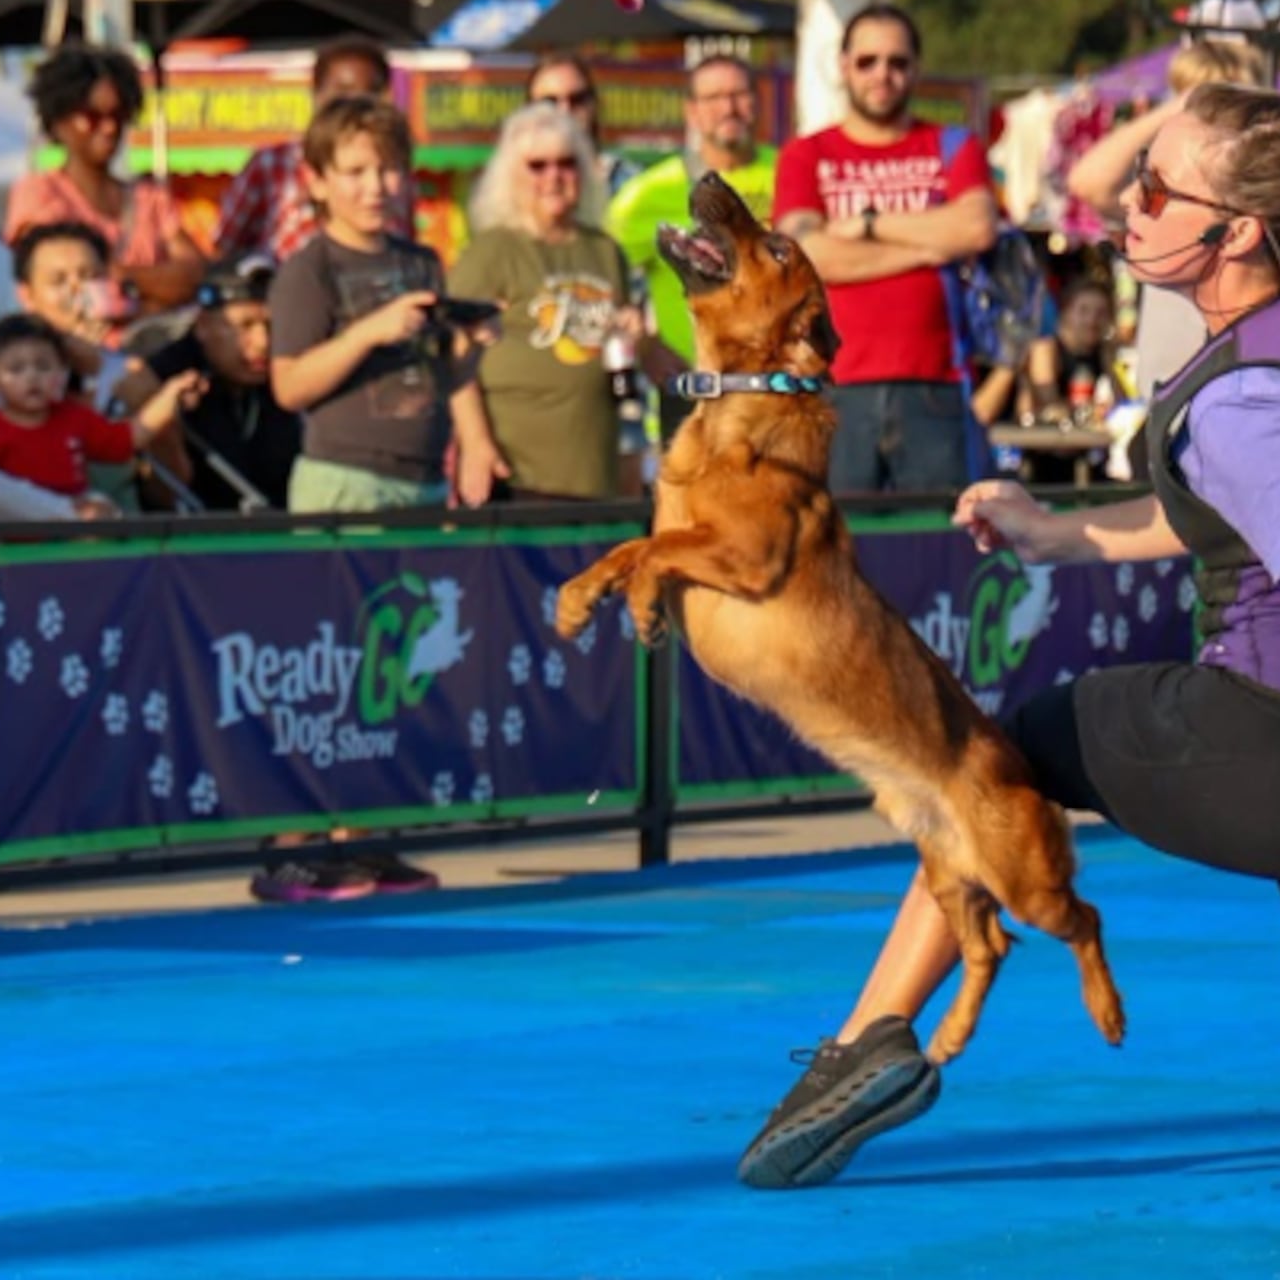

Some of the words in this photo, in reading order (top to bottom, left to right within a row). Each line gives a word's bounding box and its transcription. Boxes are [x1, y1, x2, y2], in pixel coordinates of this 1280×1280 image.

[211, 620, 361, 728] Ready
[272, 704, 334, 768] Dog
[335, 724, 398, 762] Show
